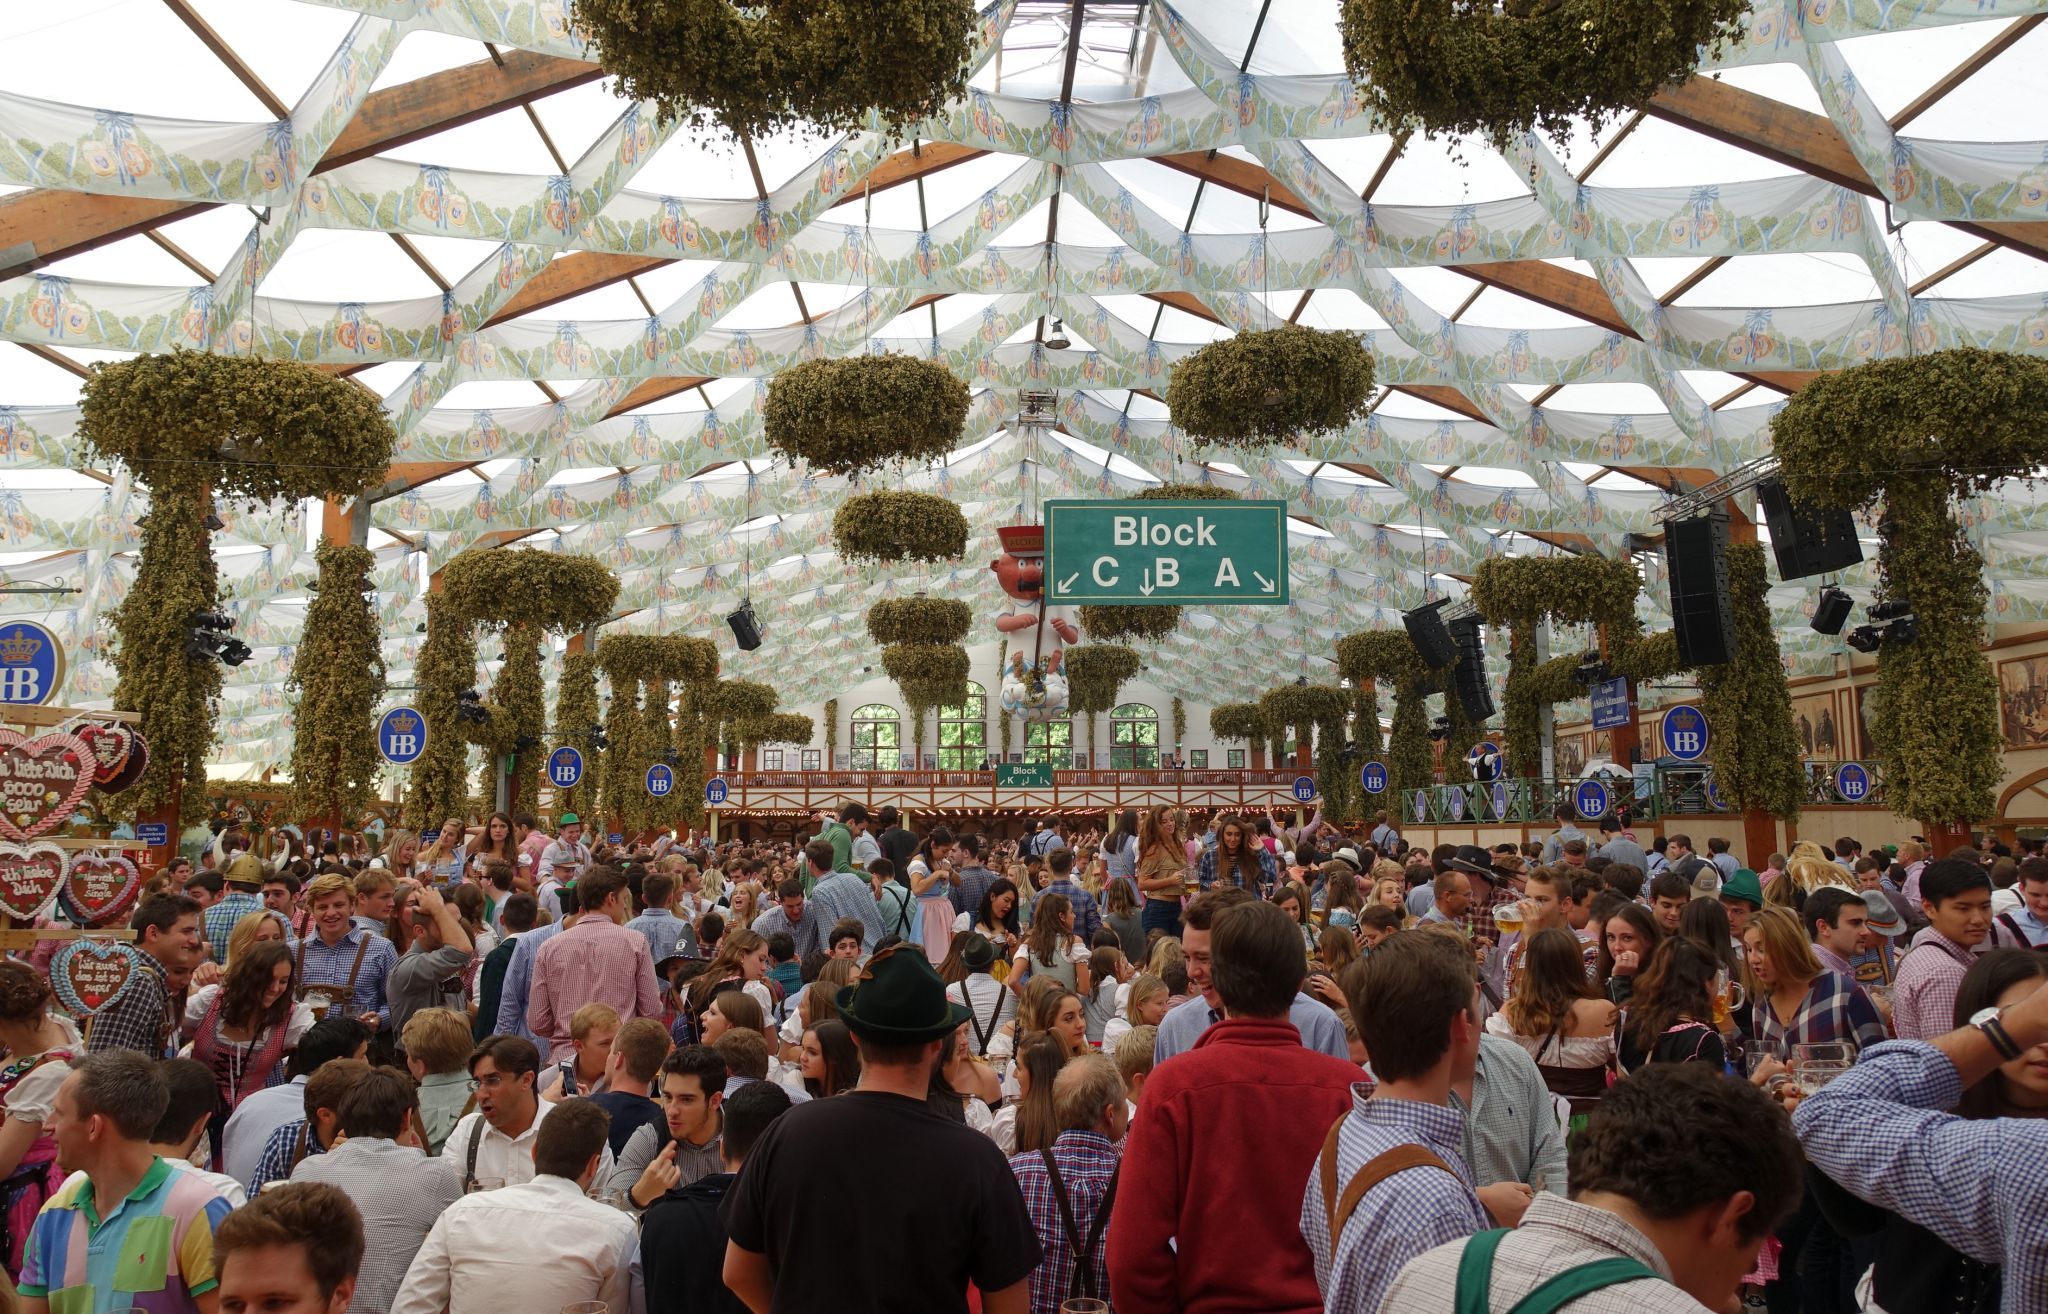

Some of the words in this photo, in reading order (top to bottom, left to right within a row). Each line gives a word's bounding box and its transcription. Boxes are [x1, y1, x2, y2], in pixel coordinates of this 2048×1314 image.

[1114, 516, 1217, 546] Block
[1092, 556, 1120, 588] C
[1155, 557, 1180, 588] B
[1214, 557, 1241, 588] A
[0, 667, 40, 701] HB
[388, 734, 417, 756] HB
[1672, 731, 1700, 752] HB
[12, 757, 44, 779] liebe
[44, 760, 77, 780] Dich
[555, 766, 576, 782] HB
[1013, 766, 1037, 775] Block
[652, 779, 668, 792] HB
[1007, 776, 1014, 784] K
[1025, 776, 1029, 784] J
[1368, 776, 1382, 788] HB
[710, 790, 723, 801] HB
[1299, 788, 1311, 799] HB
[1845, 781, 1863, 795] HB
[1583, 798, 1602, 813] HB
[23, 864, 56, 879] liebe
[10, 880, 45, 896] Dich
[75, 970, 93, 982] das
[94, 971, 108, 982] ist
[109, 974, 121, 983] so
[83, 984, 112, 996] super
